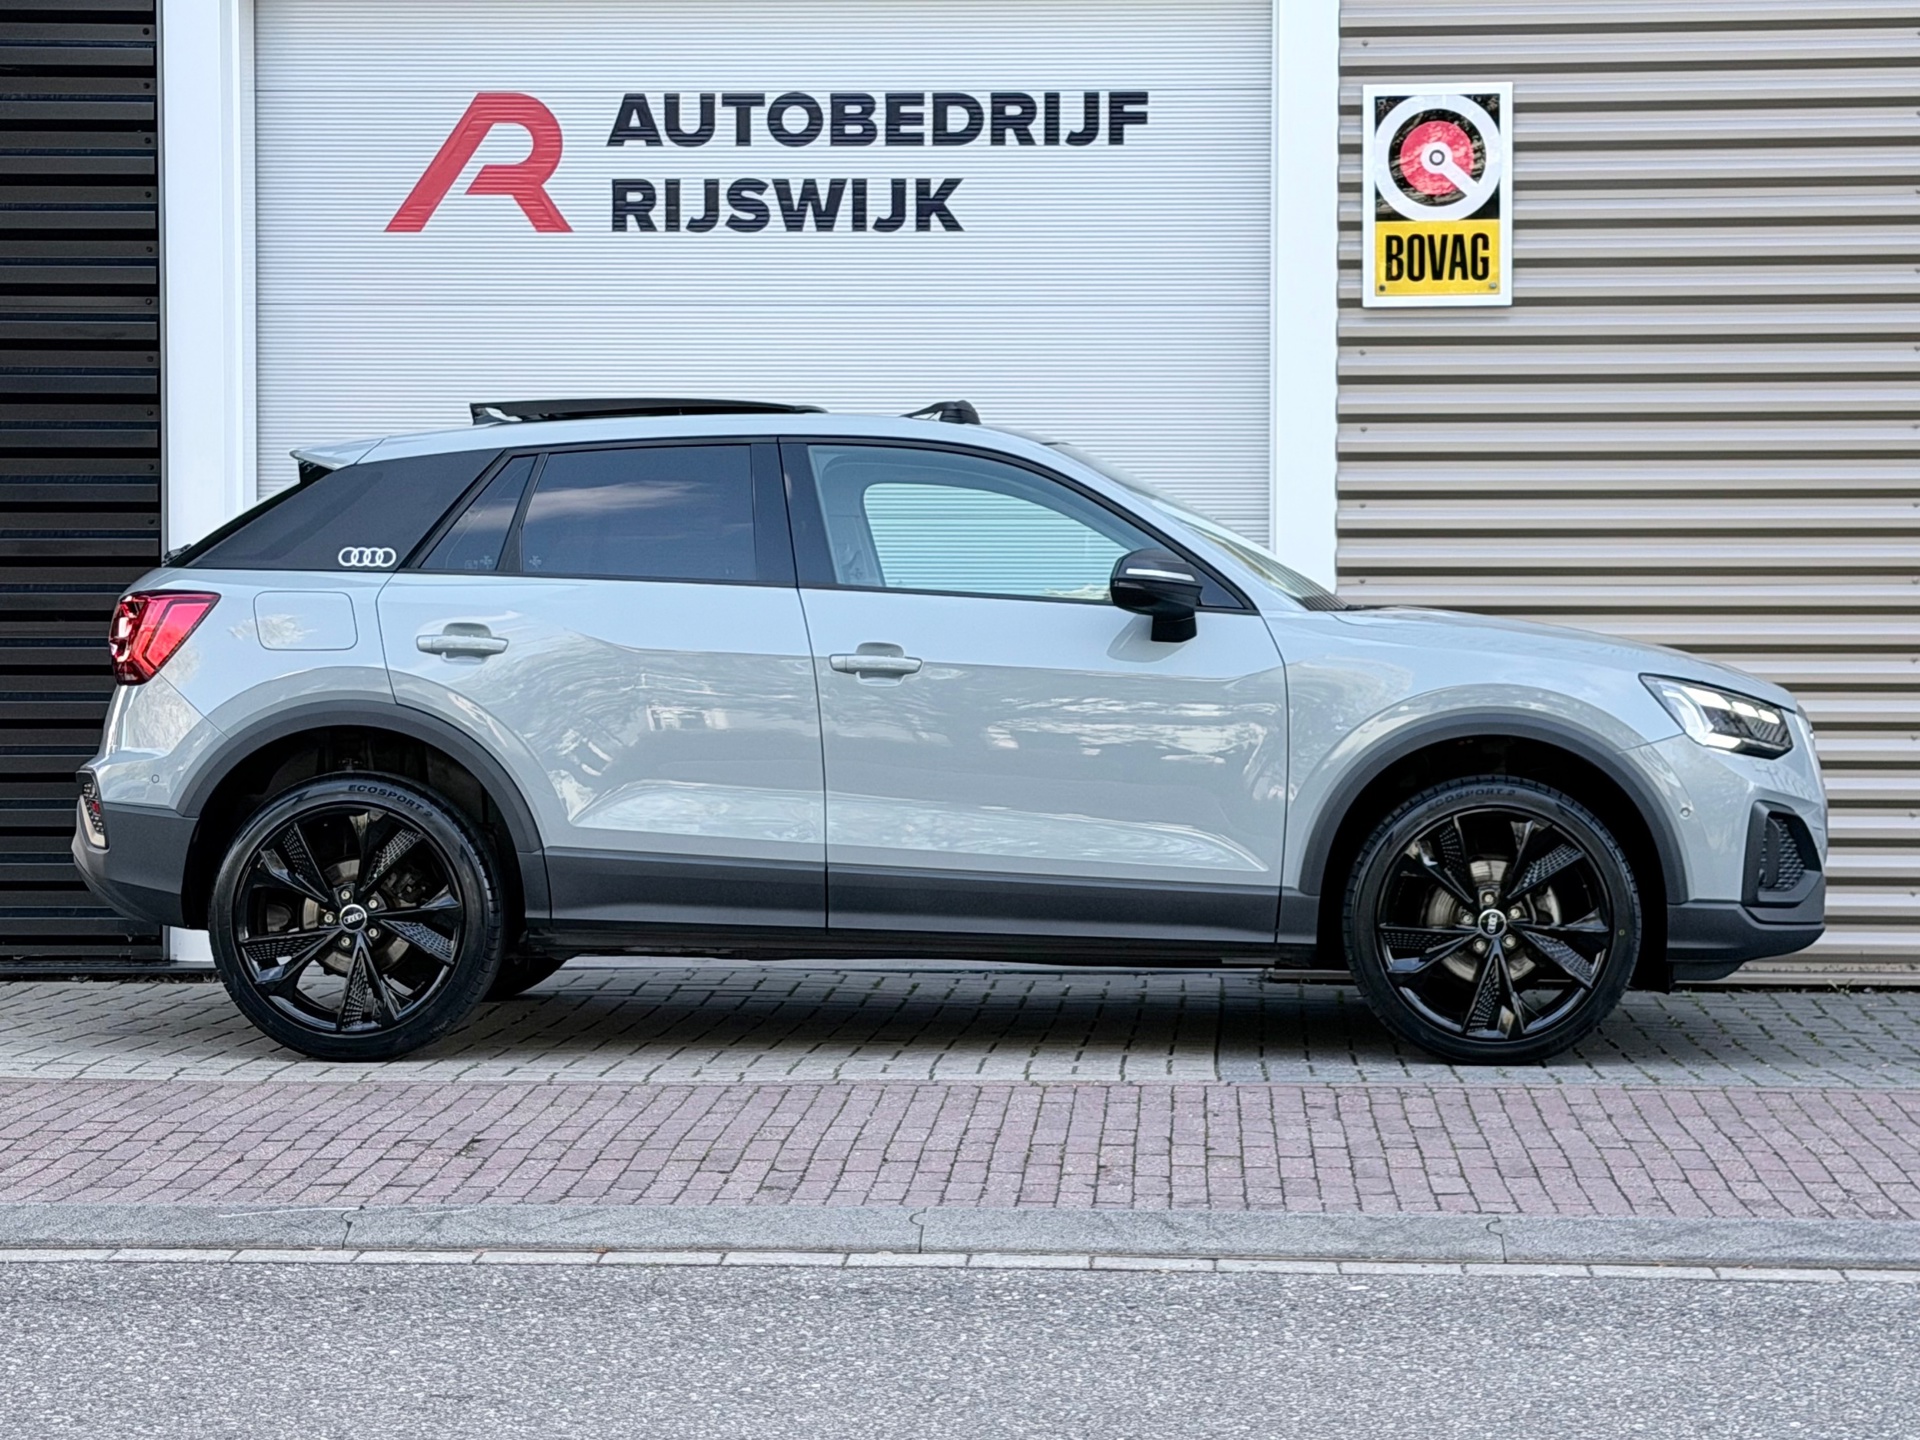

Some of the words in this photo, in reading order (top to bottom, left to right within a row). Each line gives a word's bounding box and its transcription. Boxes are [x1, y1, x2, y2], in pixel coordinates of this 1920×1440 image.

[607, 91, 1149, 147] AUTOBEDRIJF
[612, 178, 964, 233] RIJSWIJK
[1385, 233, 1490, 282] BOVAG
[348, 784, 424, 810] ECOSPORT
